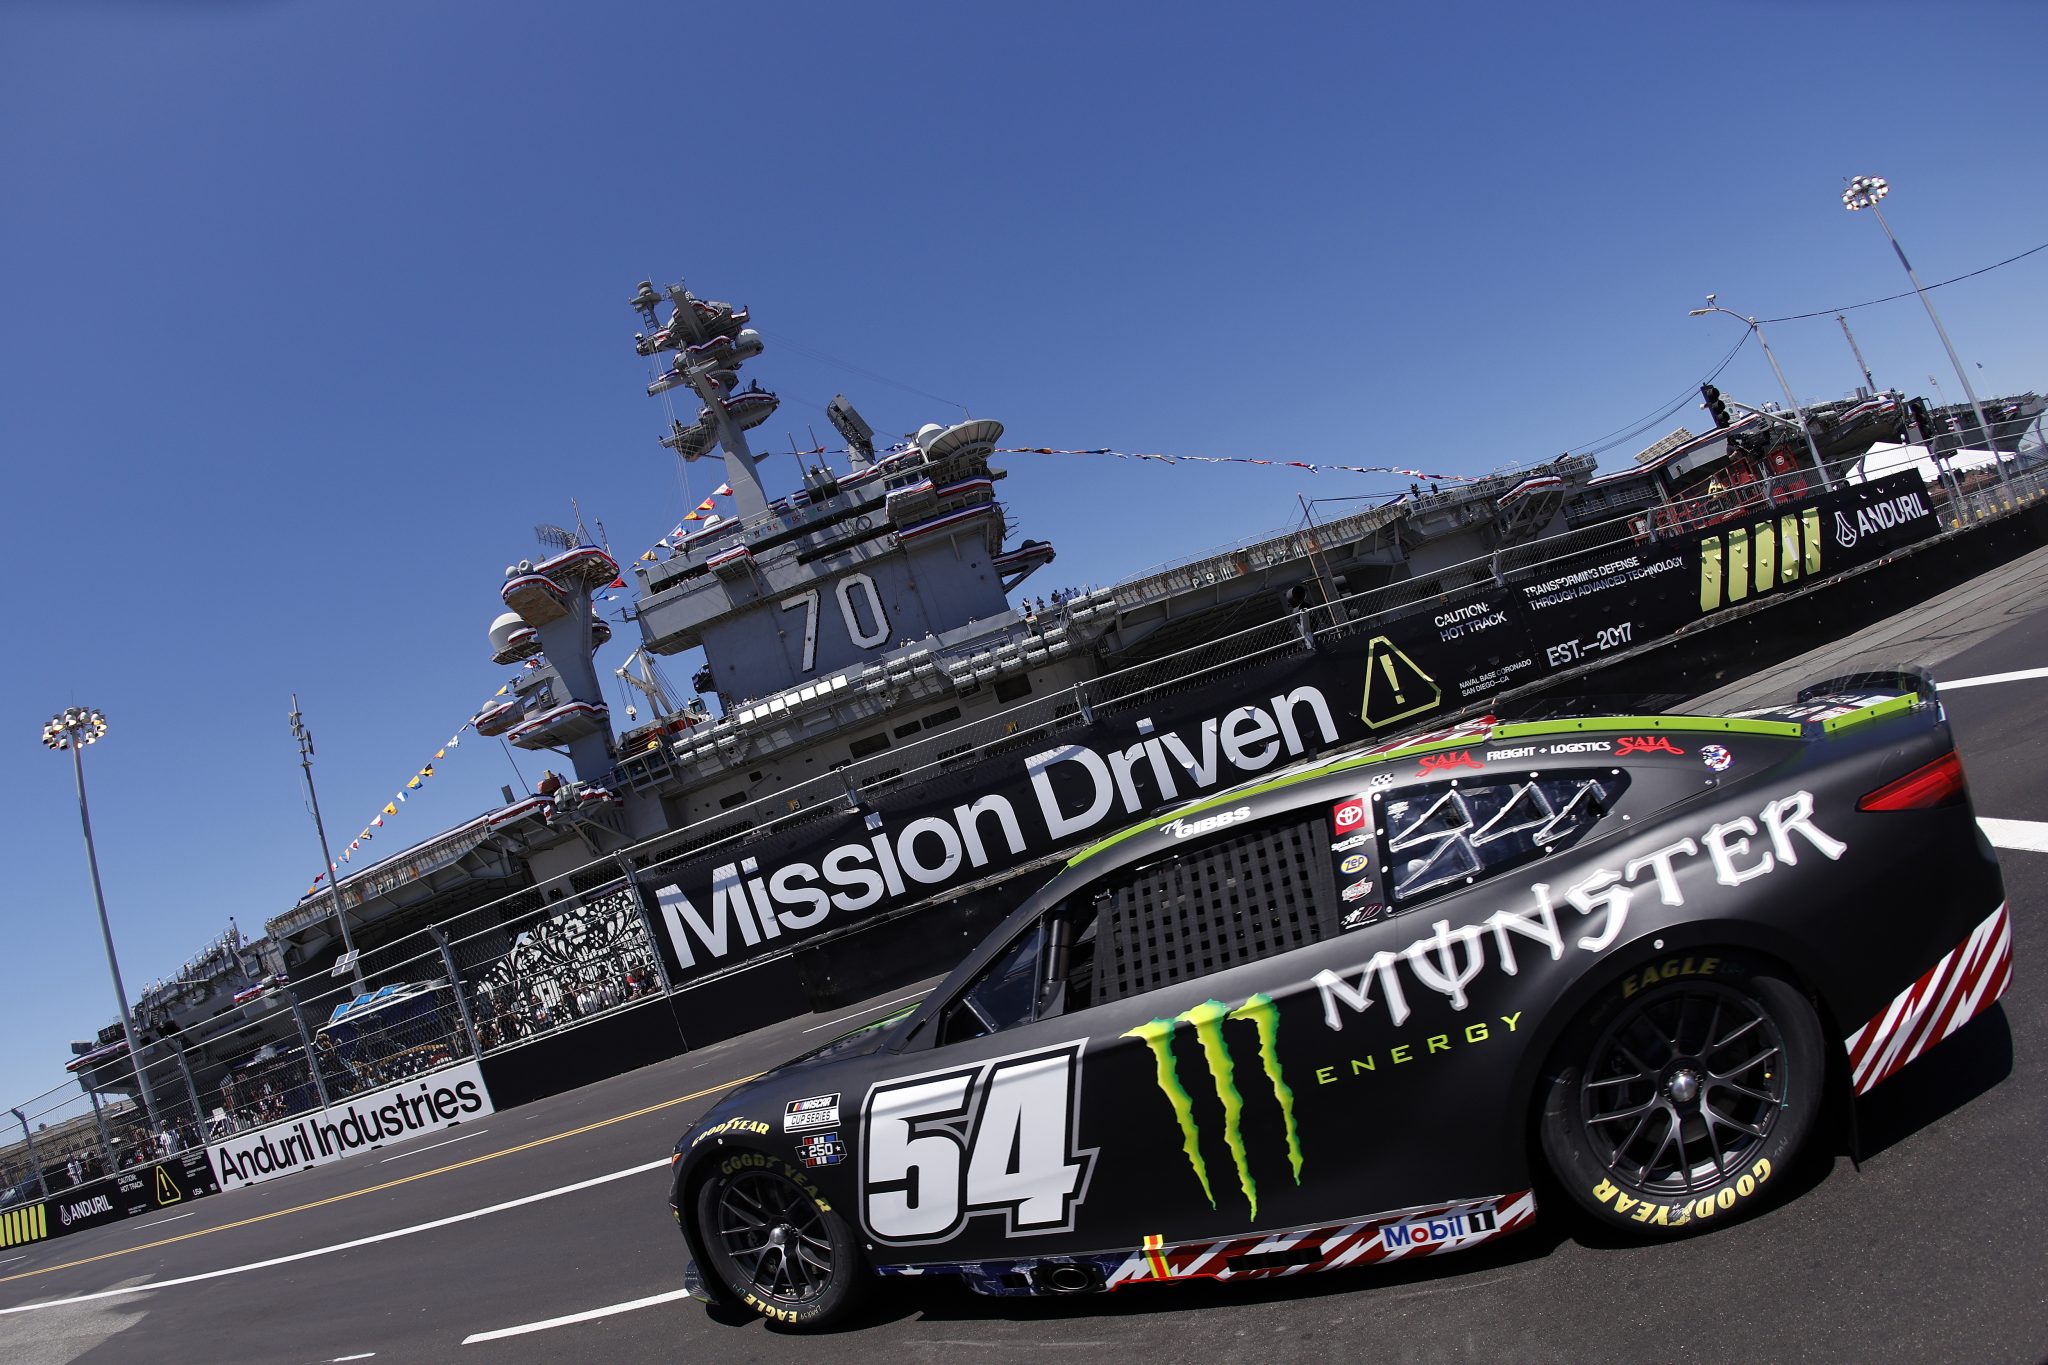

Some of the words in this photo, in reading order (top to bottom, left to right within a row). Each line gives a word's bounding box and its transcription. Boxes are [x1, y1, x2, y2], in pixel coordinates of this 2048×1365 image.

[1857, 491, 1928, 537] ANDURIL
[1523, 568, 1600, 598] TRANSFORMING
[1599, 556, 1640, 576] DEFENSE
[1528, 588, 1578, 611] THROUGH
[1578, 575, 1627, 598] ADVANCED
[1628, 556, 1683, 581] TECHNOLOGY
[780, 573, 892, 672] 70
[1434, 602, 1490, 628] CAUTION:
[1439, 624, 1466, 642] HOT
[1468, 611, 1508, 633] TRACK
[1459, 673, 1480, 690] NAVAL
[1479, 670, 1497, 684] BASE
[1496, 658, 1532, 677] CORONADO
[1461, 685, 1476, 697] SAN
[1486, 746, 1535, 761] FREIGHT
[1550, 741, 1611, 755] LOGISTICS
[655, 793, 1028, 971] Mission
[1023, 683, 1340, 840] Driven
[1174, 806, 1251, 838] GIBBS
[1310, 789, 1846, 1031] MONSTER
[1621, 957, 1721, 998] EAGLE
[1316, 1011, 1524, 1085] ENERGY
[791, 1113, 805, 1126] CUP
[805, 1110, 831, 1124] SERIES
[800, 1096, 832, 1111] NASCAR
[219, 1122, 316, 1185] Anduril
[310, 1080, 483, 1157] Industries
[691, 1116, 770, 1147] GOODYEAR
[864, 1047, 1090, 1242] 54
[808, 1143, 834, 1157] 250
[72, 1195, 114, 1220] ANDURIL
[192, 1187, 204, 1196] USA
[1383, 1215, 1464, 1248] Mobil
[1474, 1212, 1487, 1231] 1
[743, 1293, 798, 1324] EAGLE
